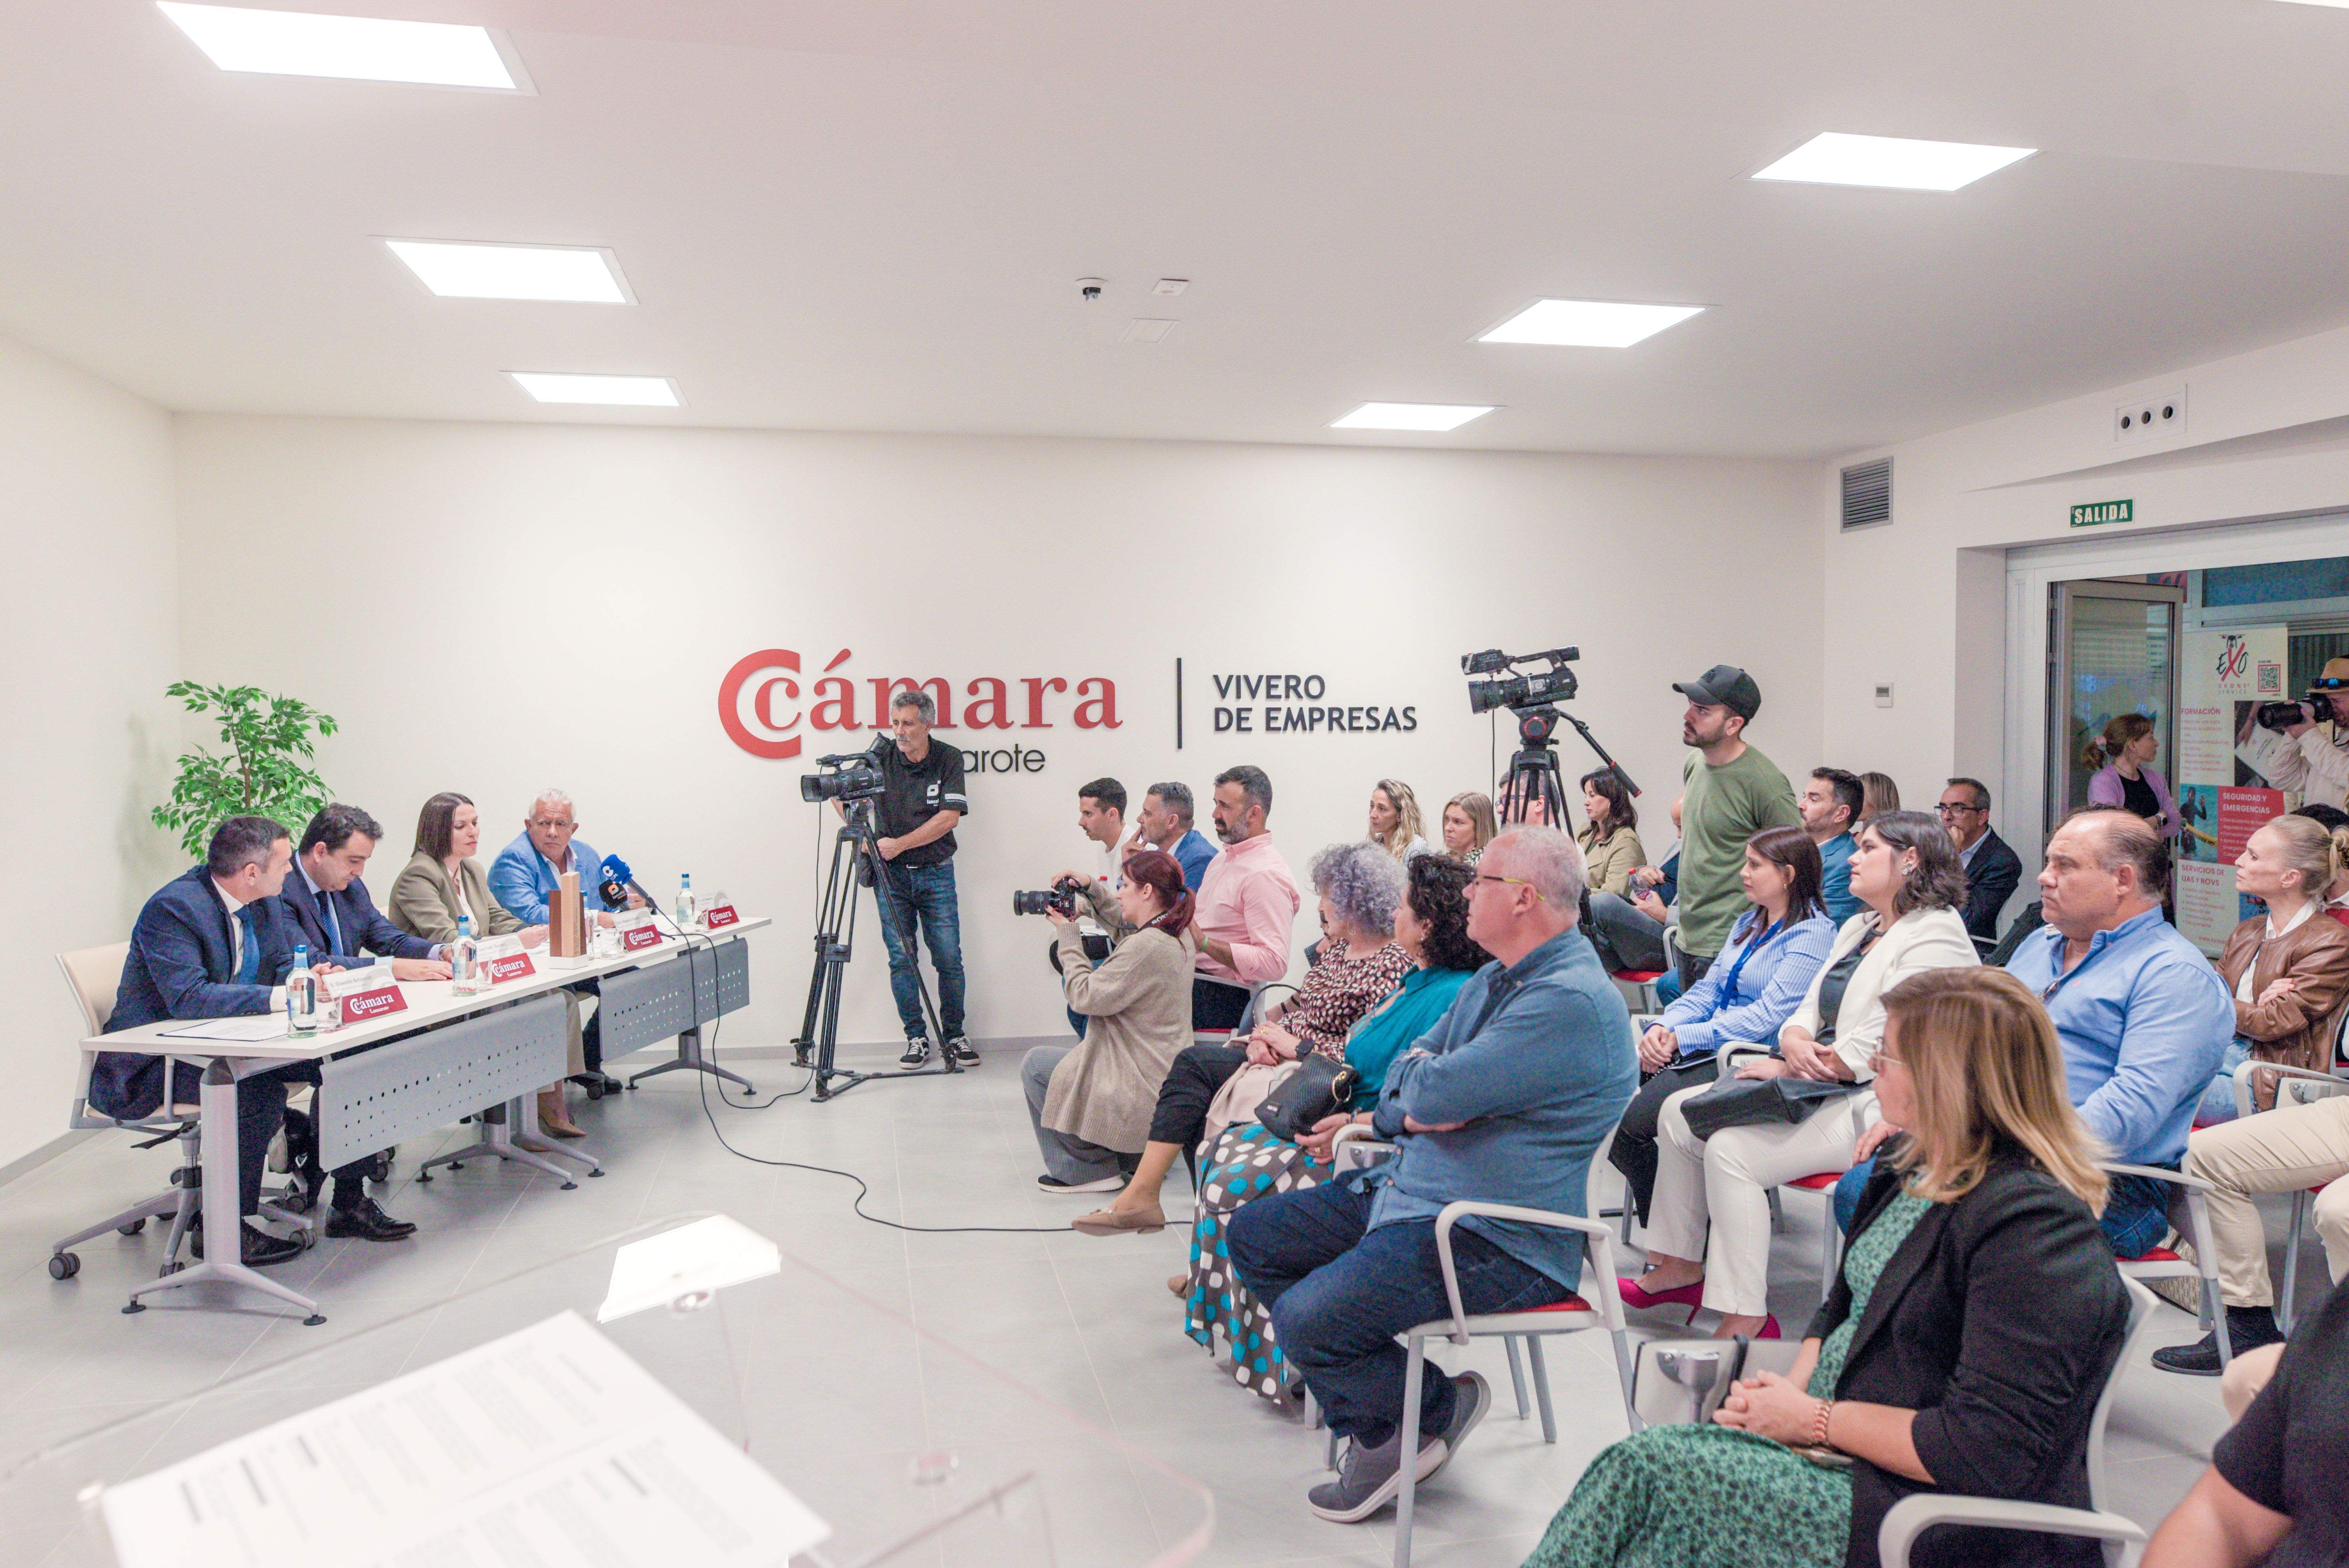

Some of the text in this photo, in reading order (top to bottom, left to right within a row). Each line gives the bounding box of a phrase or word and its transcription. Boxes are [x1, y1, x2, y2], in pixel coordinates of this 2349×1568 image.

[2075, 503, 2128, 524] SALIDA
[1213, 674, 1325, 700] VIVERO
[2181, 707, 2221, 715] FORMACIÓN
[1214, 706, 1418, 732] DE EMPRESAS
[963, 743, 1045, 773] arote
[2223, 793, 2261, 801] SEGURIDAD
[2223, 804, 2270, 814] EMERGENCIAS
[2182, 865, 2215, 875] SERVICIOS
[2201, 878, 2219, 886] ROVS
